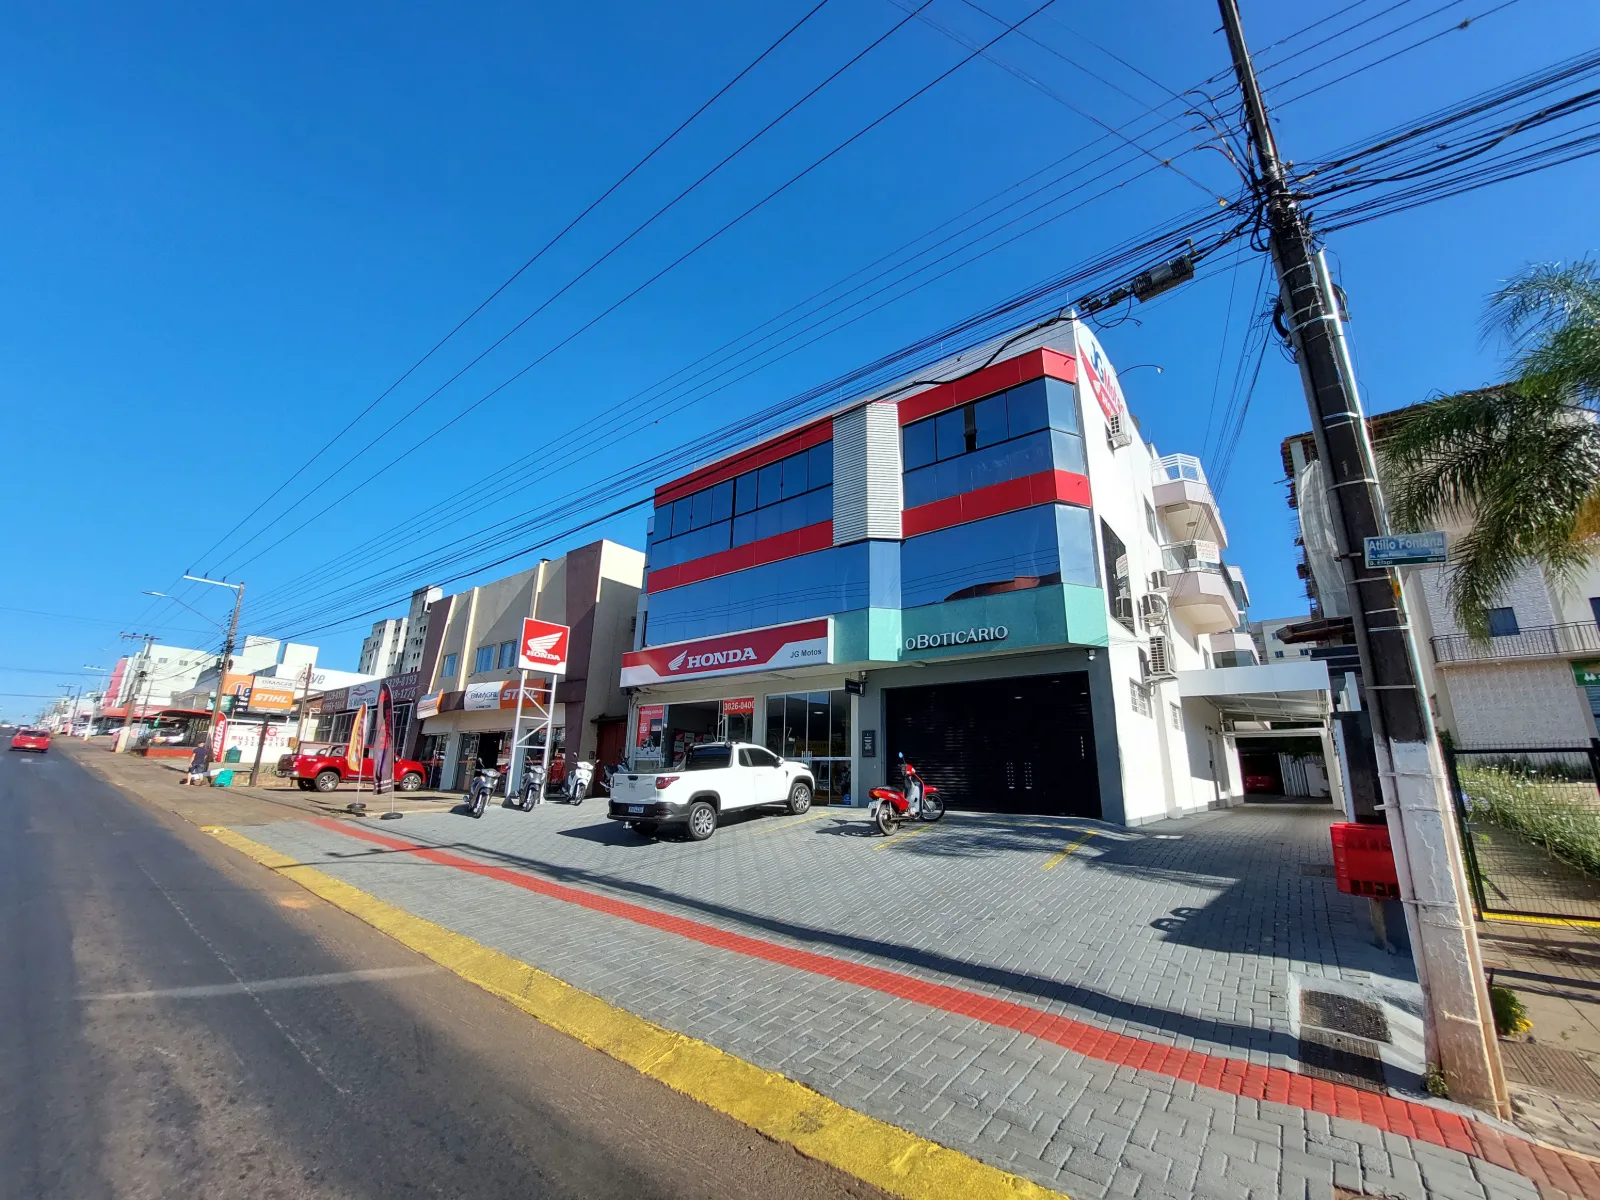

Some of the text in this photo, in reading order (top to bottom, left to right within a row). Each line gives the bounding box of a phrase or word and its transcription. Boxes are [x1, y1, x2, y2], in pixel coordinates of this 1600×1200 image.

[1399, 537, 1443, 549] Fontana
[526, 650, 560, 660] HONDA
[687, 647, 757, 668] HONDA
[790, 648, 822, 658] JG Motos
[254, 693, 289, 703] STIHL
[502, 688, 539, 700] STL
[724, 701, 755, 710] 3026-0400
